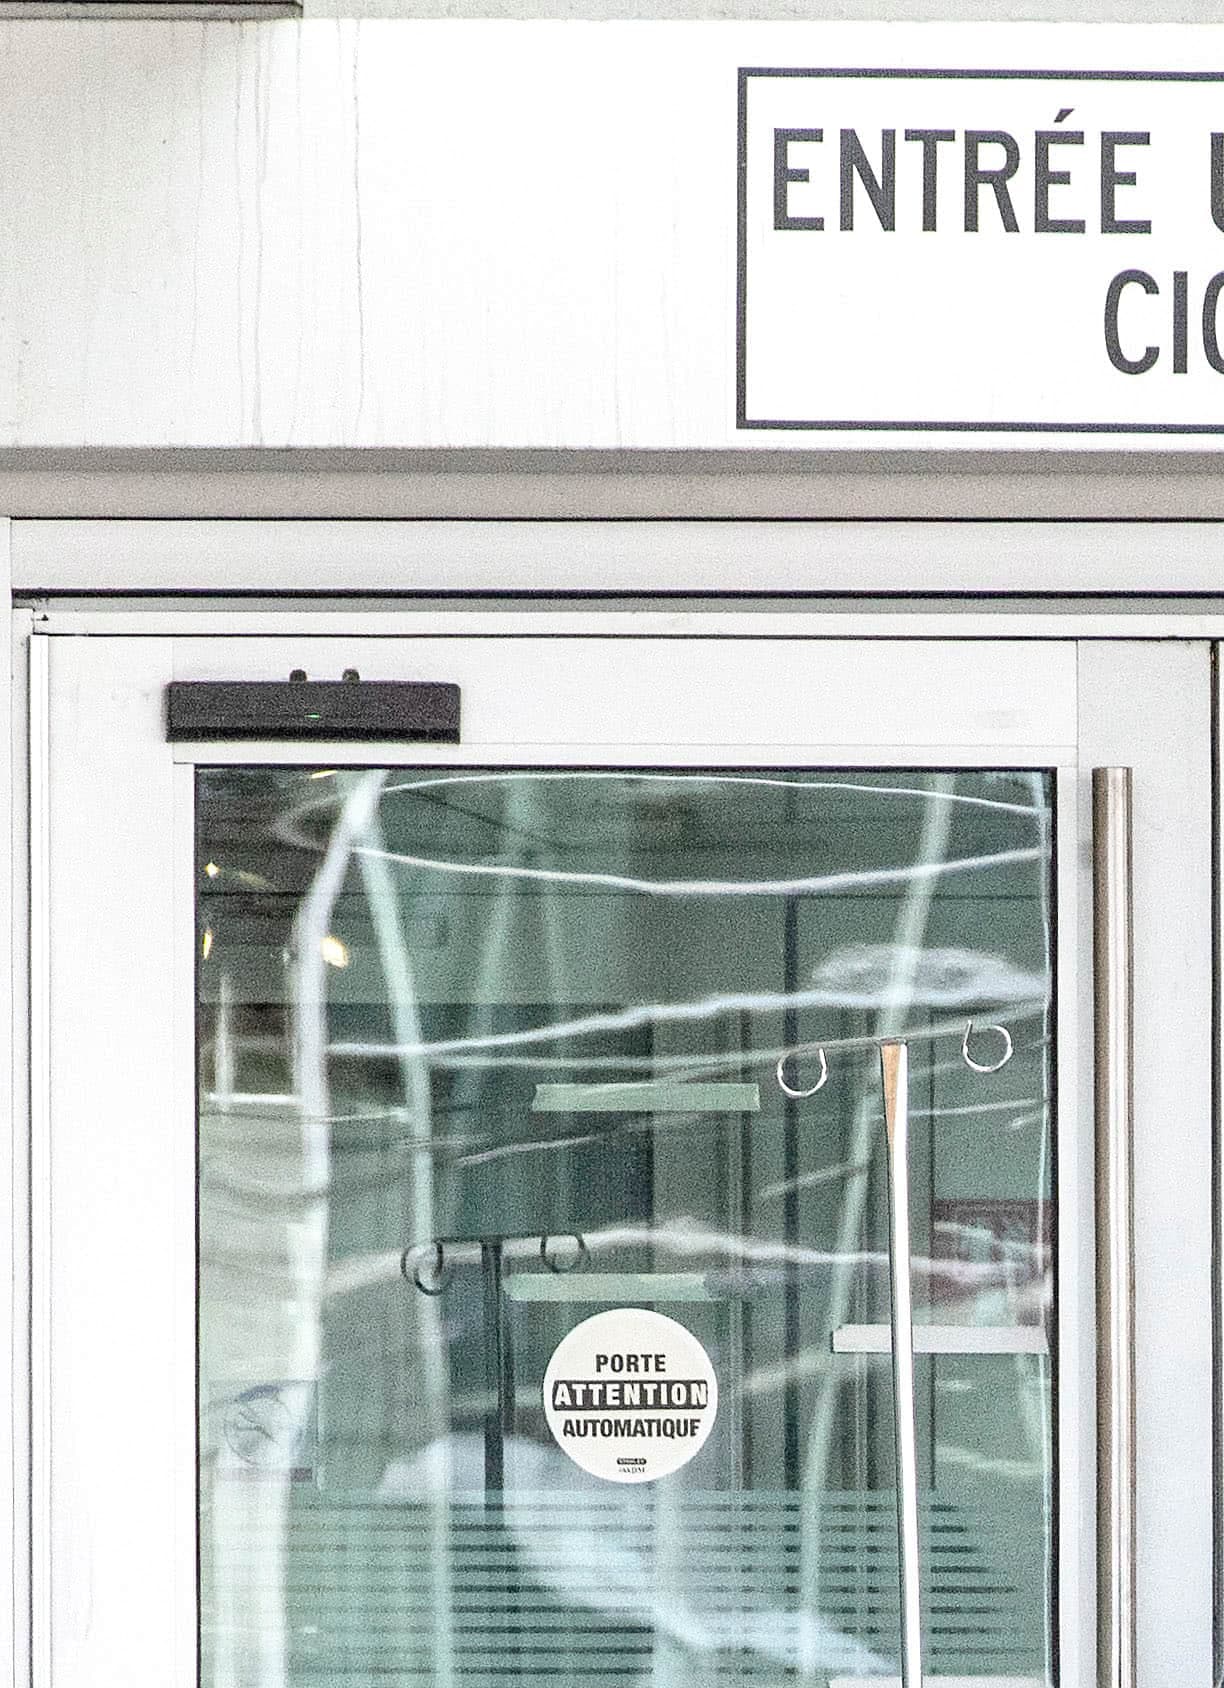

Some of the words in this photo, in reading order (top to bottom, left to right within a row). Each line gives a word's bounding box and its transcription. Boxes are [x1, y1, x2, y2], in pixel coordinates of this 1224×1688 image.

[773, 107, 1153, 235] ENTRÉE
[595, 1354, 667, 1373] PORTE
[554, 1382, 708, 1406] ATTENTION
[562, 1418, 702, 1440] AUTOMATIQUE
